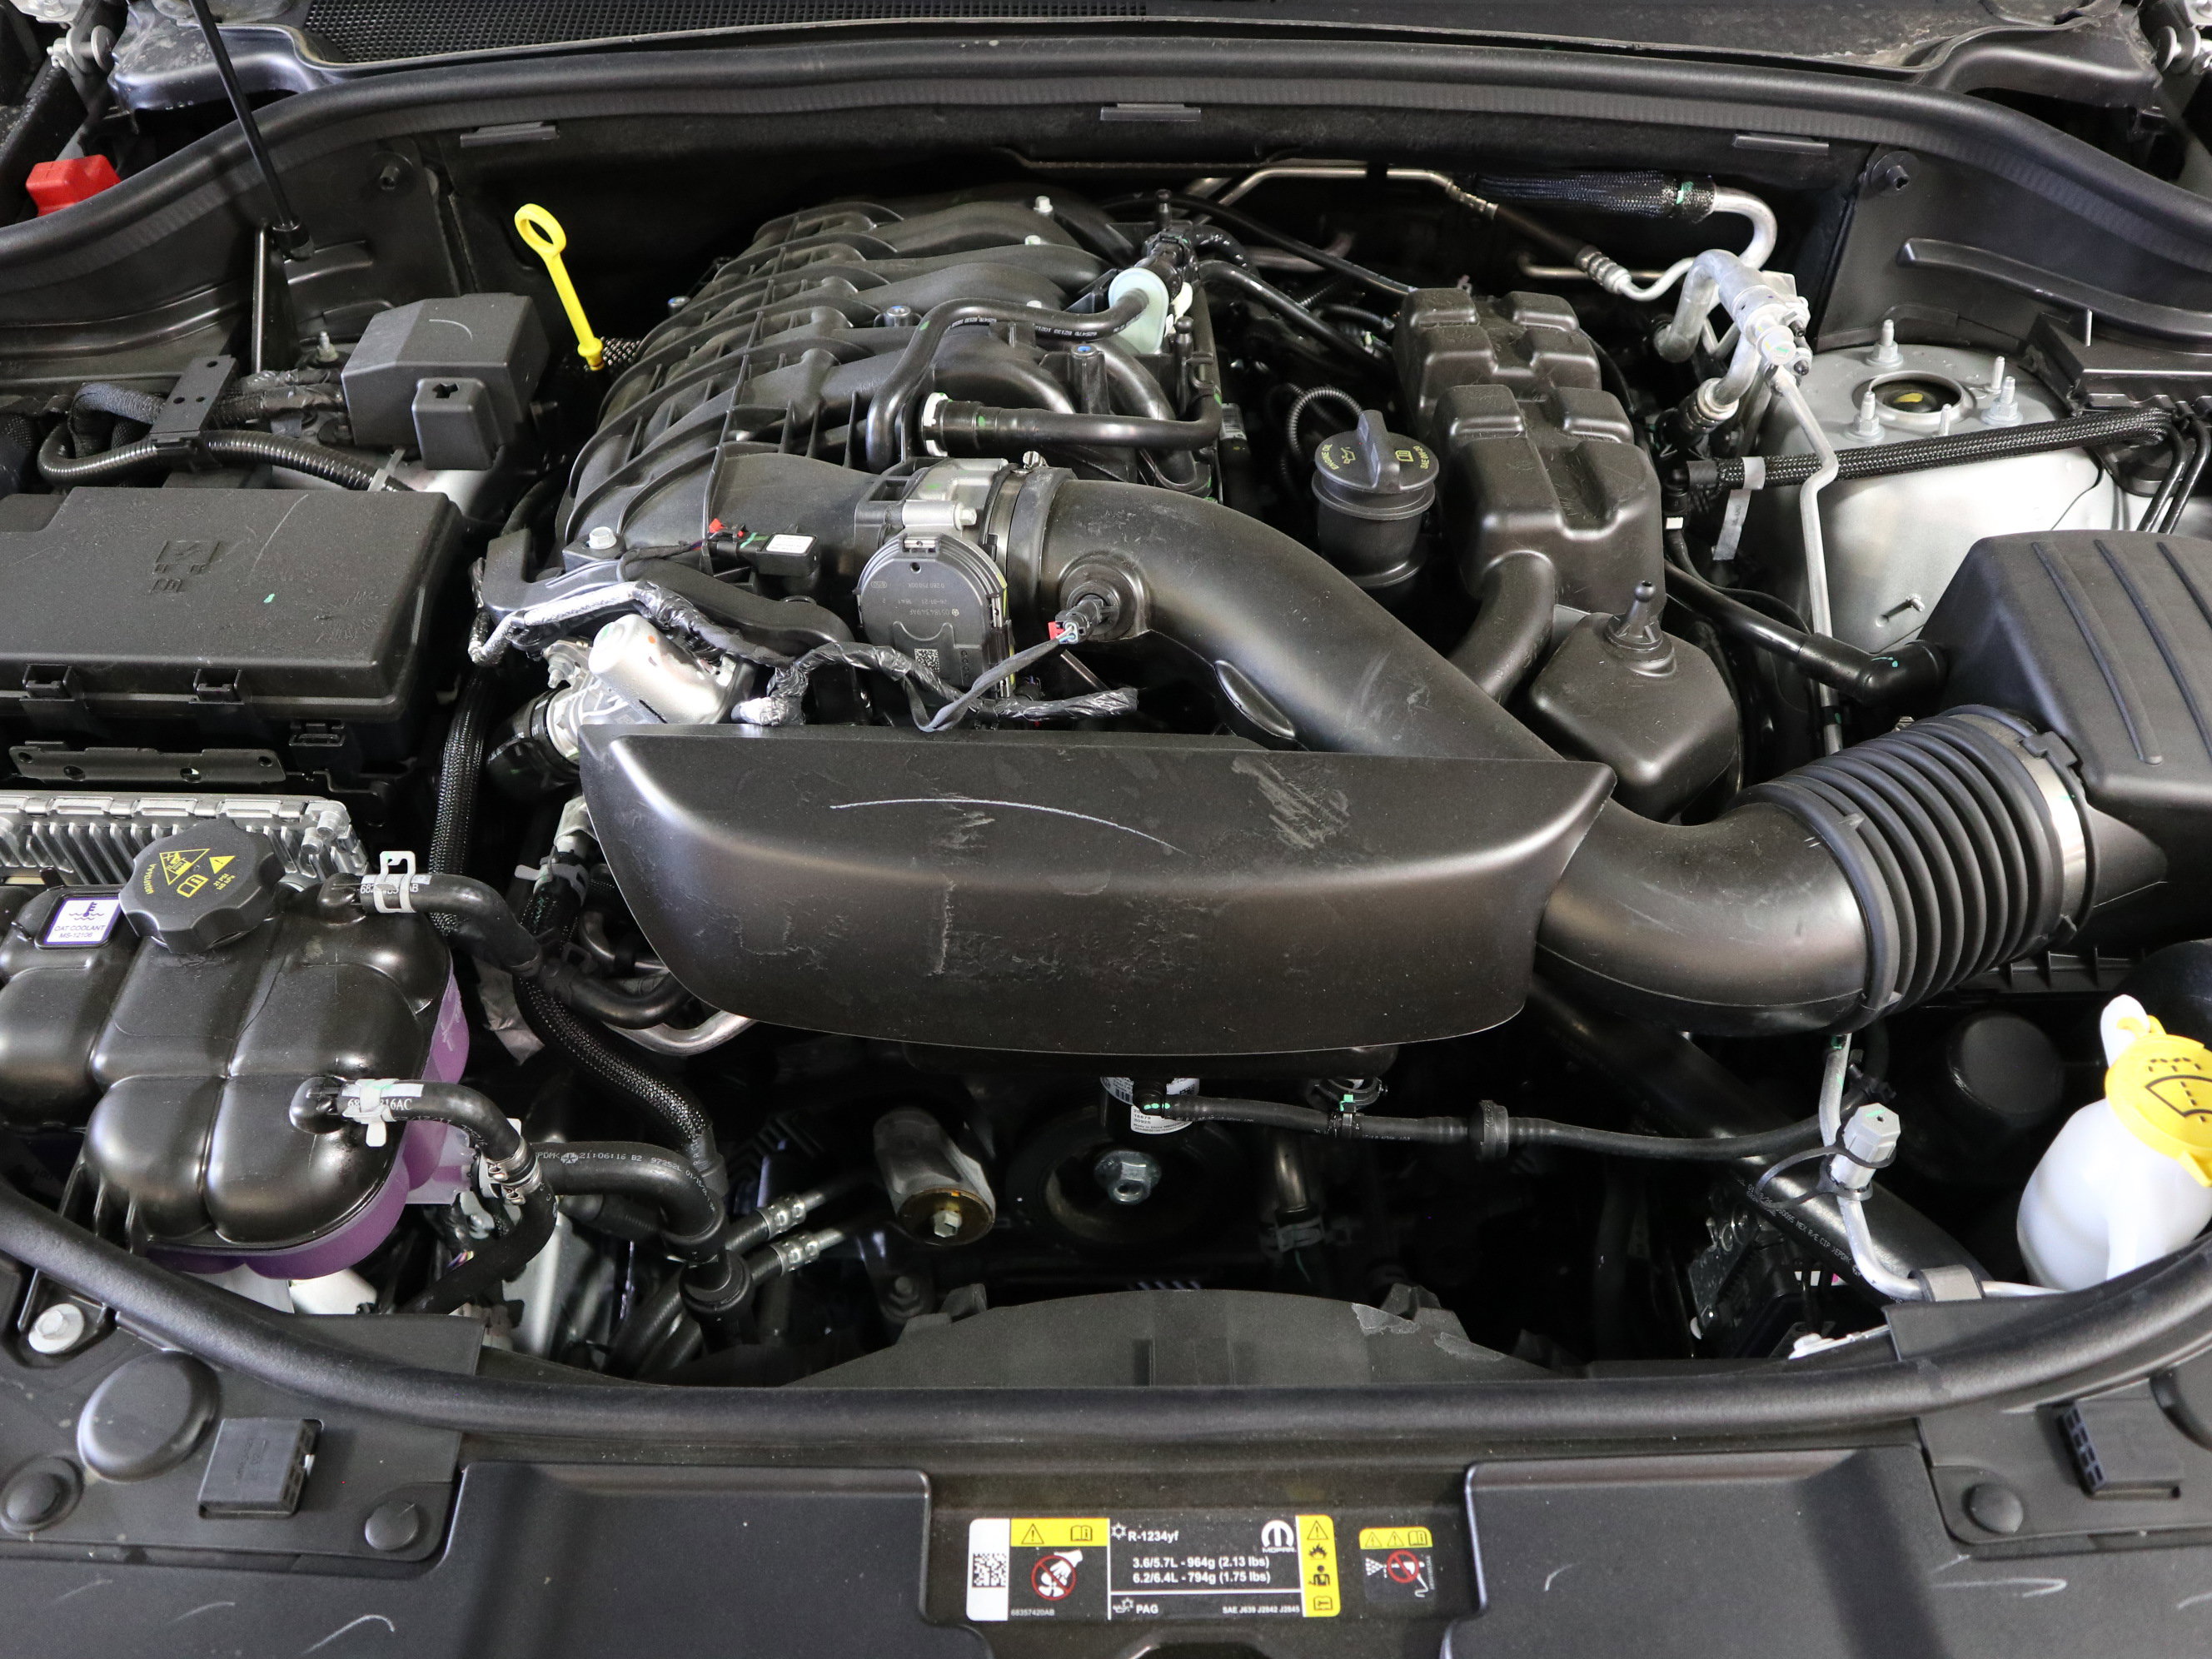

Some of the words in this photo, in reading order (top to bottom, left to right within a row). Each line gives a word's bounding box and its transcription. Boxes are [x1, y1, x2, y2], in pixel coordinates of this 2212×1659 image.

[579, 1152, 626, 1160] 21:06:16
[1128, 1531, 1178, 1543] R-1234yf
[1133, 1557, 1178, 1568] 3.6/5.7L
[1187, 1557, 1216, 1569] 964g
[1218, 1556, 1246, 1568] (2.13
[1248, 1556, 1270, 1568] lbs)
[1133, 1572, 1178, 1583] 6.2/6.4L
[1188, 1572, 1216, 1585] 794g
[1218, 1572, 1247, 1584] (1.75
[1248, 1571, 1271, 1583] lbs)
[1136, 1604, 1158, 1614] PAG
